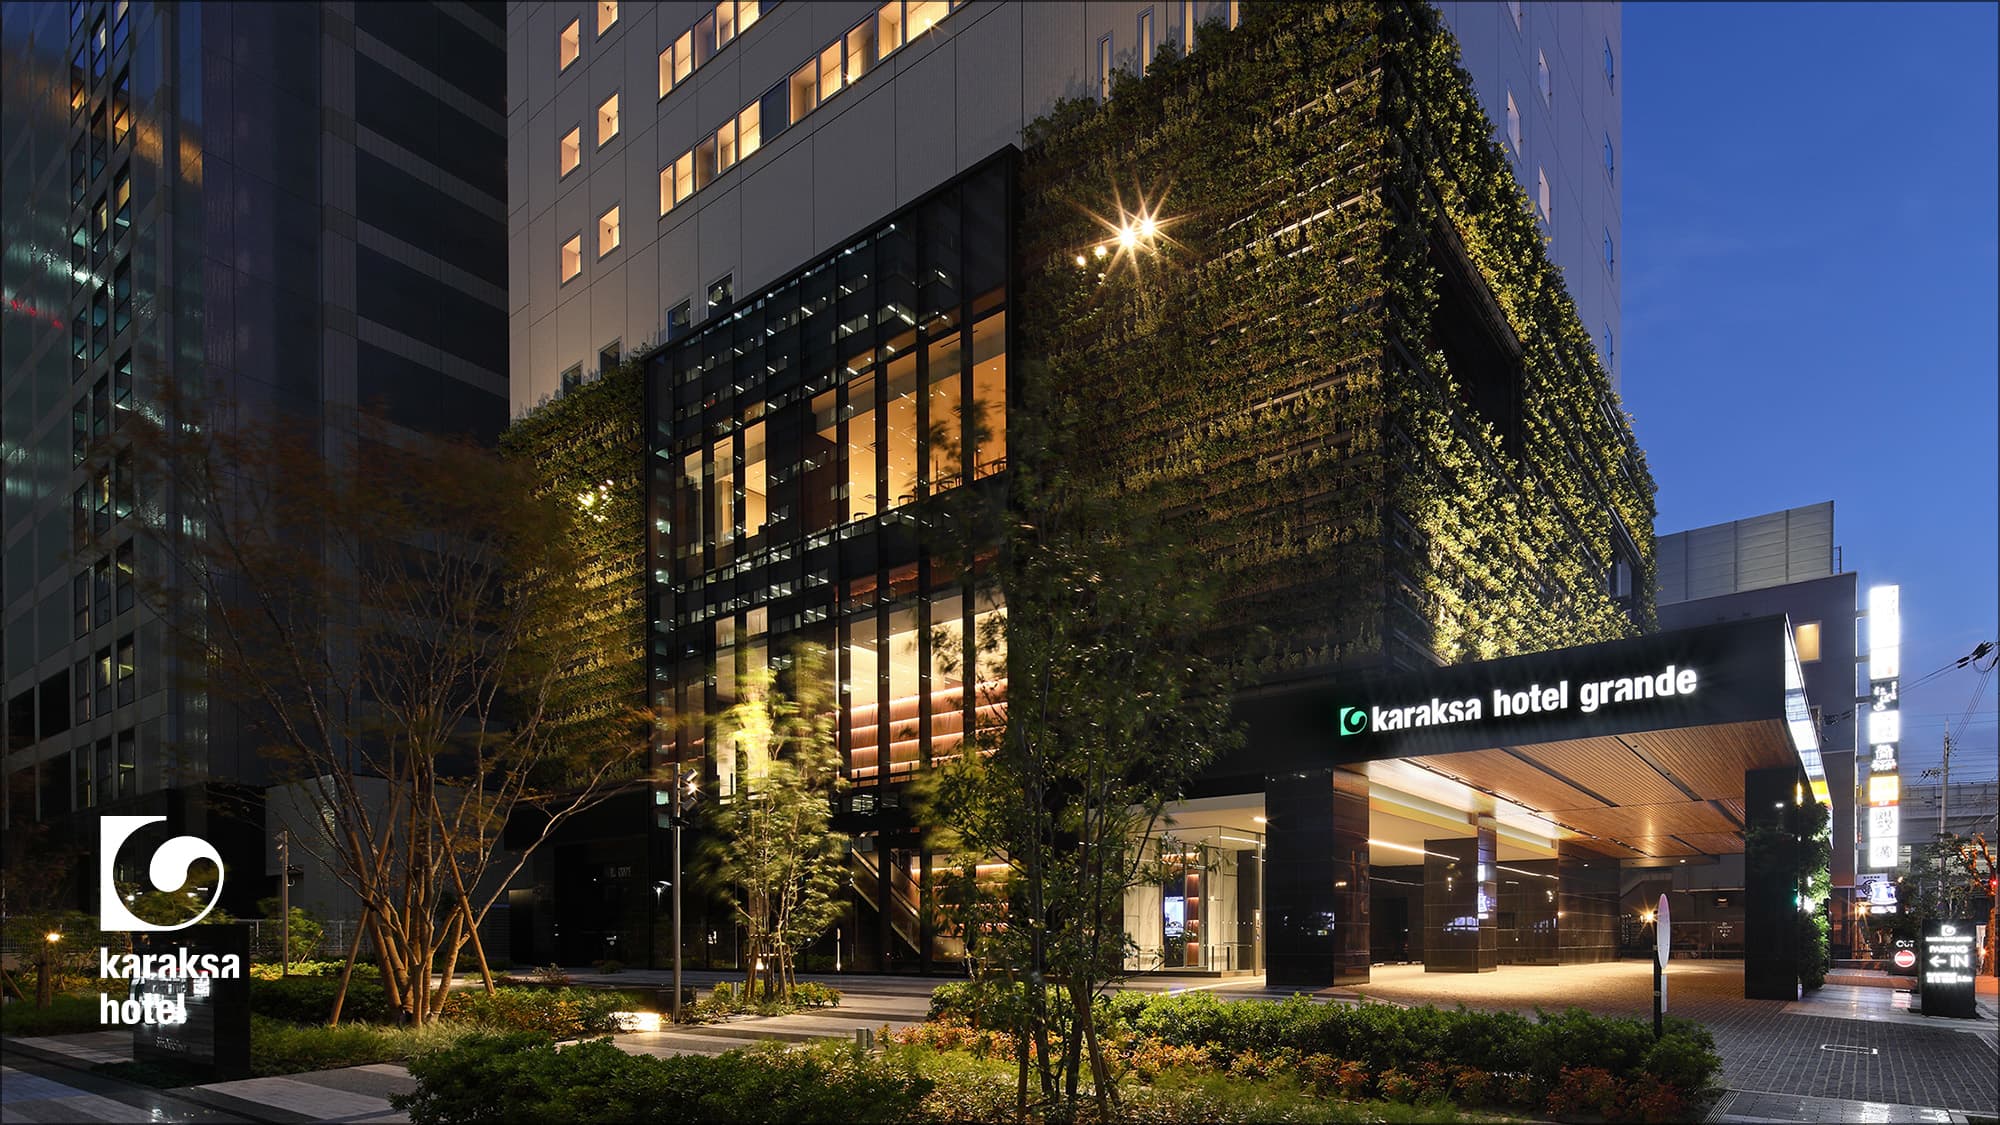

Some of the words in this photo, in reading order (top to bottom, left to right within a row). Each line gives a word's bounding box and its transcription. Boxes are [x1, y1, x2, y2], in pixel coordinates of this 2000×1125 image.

[1372, 698, 1481, 732] karaksa
[1494, 680, 1568, 717] hotel
[1580, 665, 1698, 713] grande
[1896, 940, 1914, 948] OUT
[1950, 954, 1969, 968] IN
